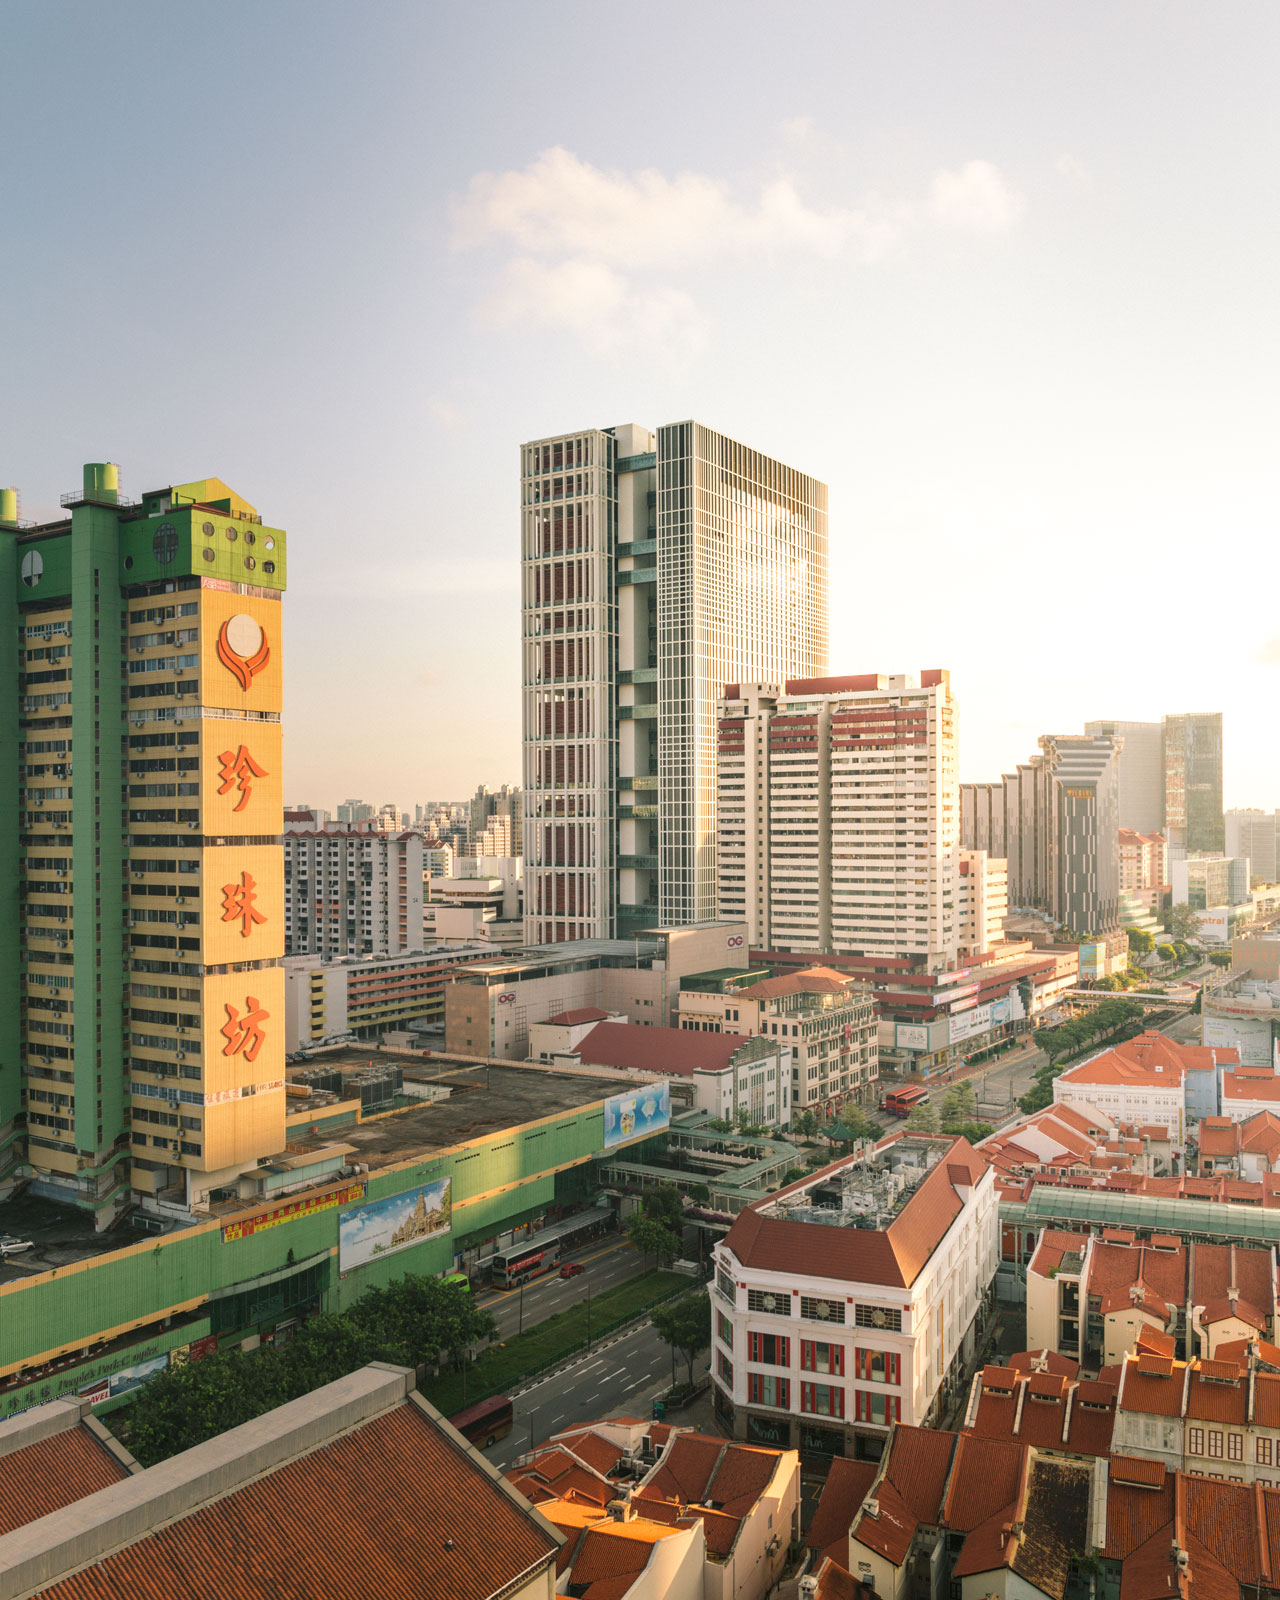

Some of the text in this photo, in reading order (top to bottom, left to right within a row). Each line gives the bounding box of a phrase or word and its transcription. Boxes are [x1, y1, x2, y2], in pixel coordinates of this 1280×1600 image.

[217, 745, 270, 1062] 珍珠坊
[728, 936, 743, 947] OG
[499, 993, 515, 1003] OG
